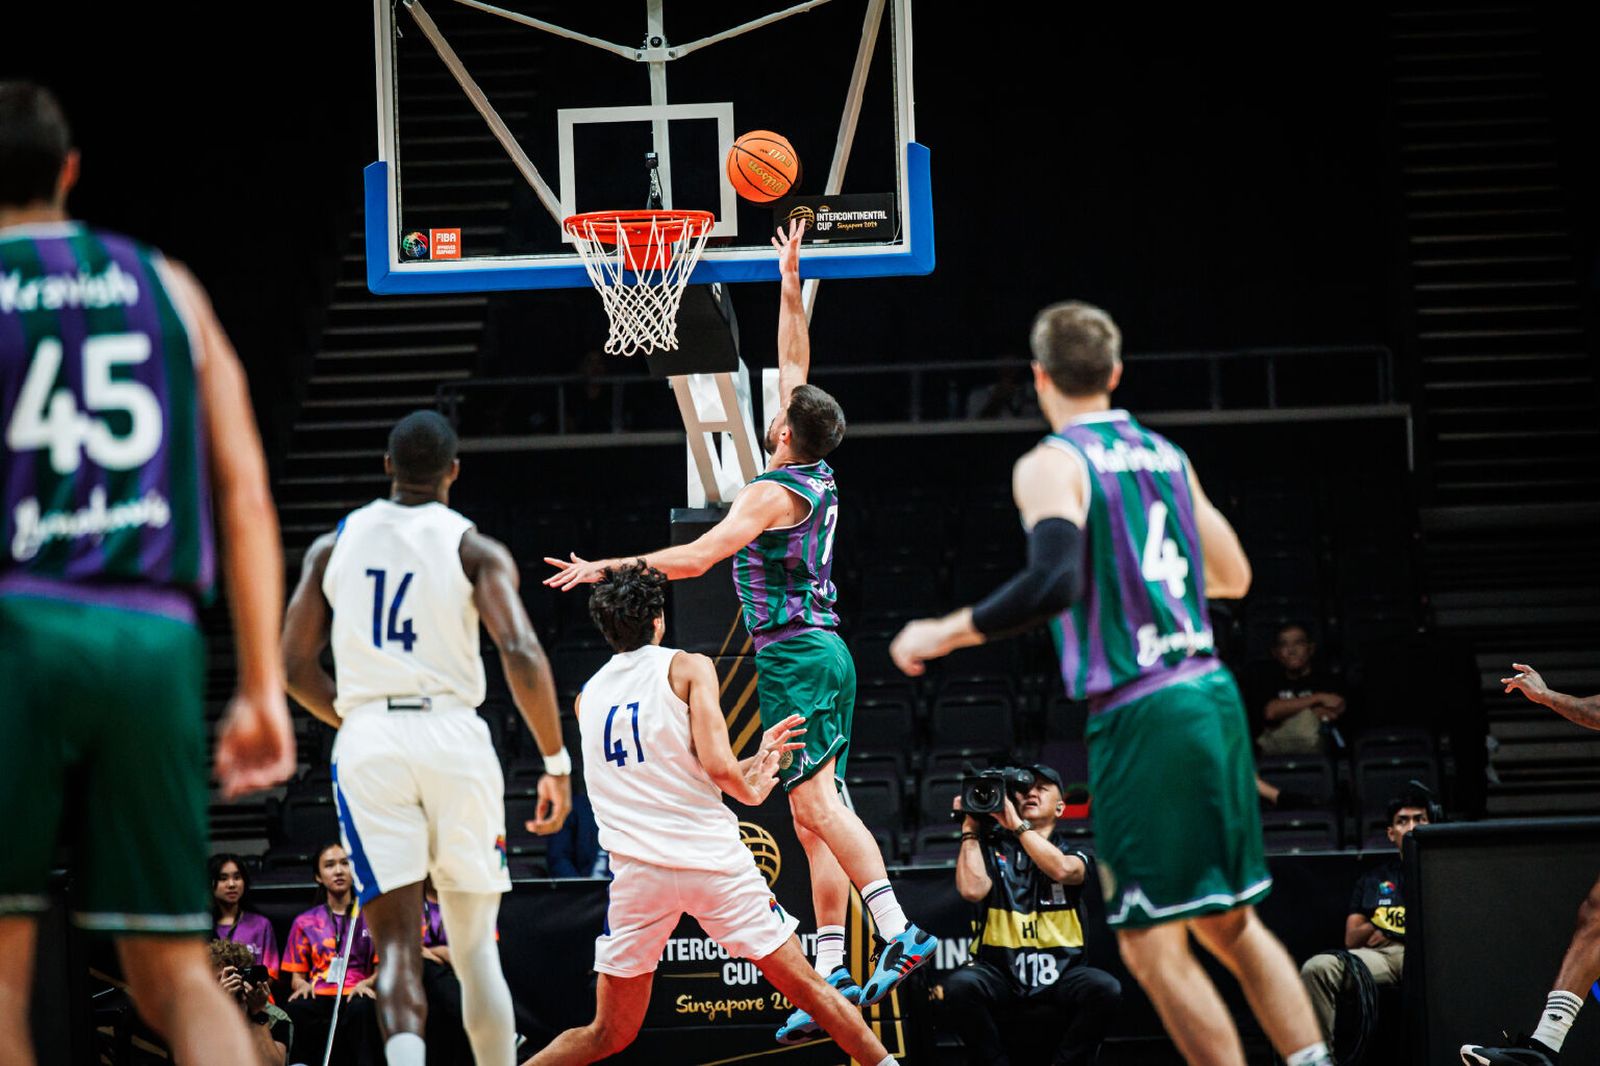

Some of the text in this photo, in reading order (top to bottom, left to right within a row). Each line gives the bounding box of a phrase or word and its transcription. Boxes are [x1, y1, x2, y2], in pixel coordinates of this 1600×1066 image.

[748, 160, 786, 193] Wilson
[816, 210, 887, 222] INTERCONTINENTAL
[817, 222, 832, 231] CUP
[436, 232, 457, 243] FIBA
[7, 332, 163, 474] 45
[1142, 501, 1189, 598] 4
[366, 568, 417, 652] 14
[603, 701, 645, 767] 41
[676, 994, 765, 1021] Singapore
